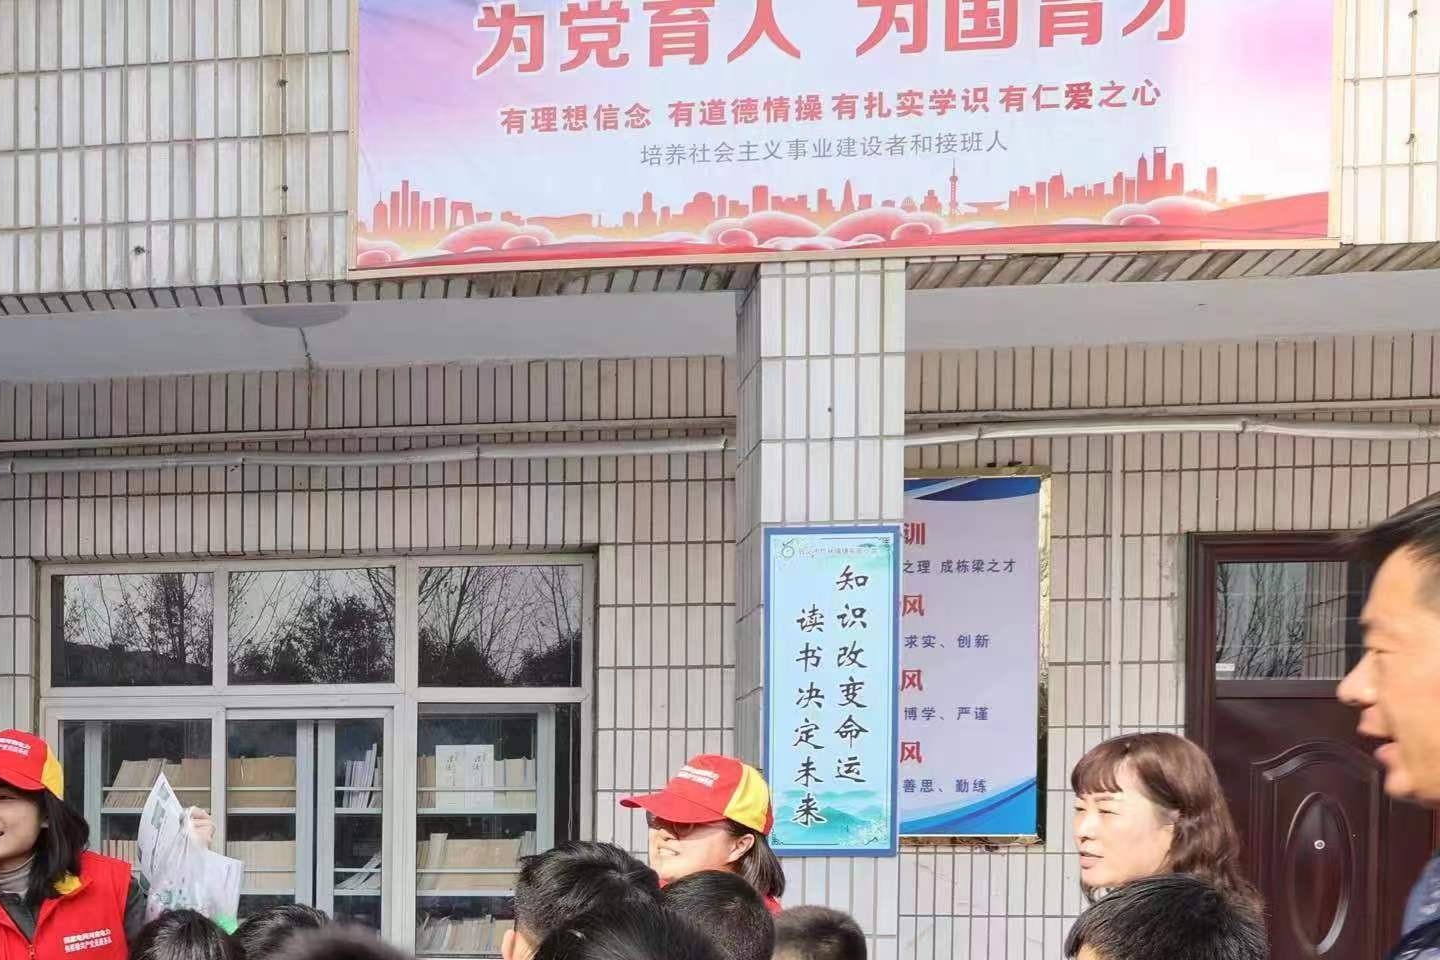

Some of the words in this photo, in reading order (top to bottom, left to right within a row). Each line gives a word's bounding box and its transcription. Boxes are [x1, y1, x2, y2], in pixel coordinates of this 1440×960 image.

[476, 0, 801, 76] 为党育人
[500, 103, 652, 135] 有理想信念
[668, 94, 823, 128] 有道德情操
[832, 86, 991, 120] 有扎实学识
[999, 79, 1161, 113] 有仁爱之心
[640, 129, 1009, 167] 培养社会主义事业建设者和接班人
[902, 522, 926, 545] 训
[940, 558, 1017, 574] 成栋梁之才
[901, 594, 925, 616] 风
[904, 633, 990, 649] 求实、创新
[834, 564, 870, 784] 知识改变命运
[900, 669, 924, 691] 风
[791, 602, 827, 827] 读书决定未来
[903, 706, 989, 720] 博学、严谨
[899, 741, 922, 763] 风
[902, 778, 988, 793] 善思、勤练
